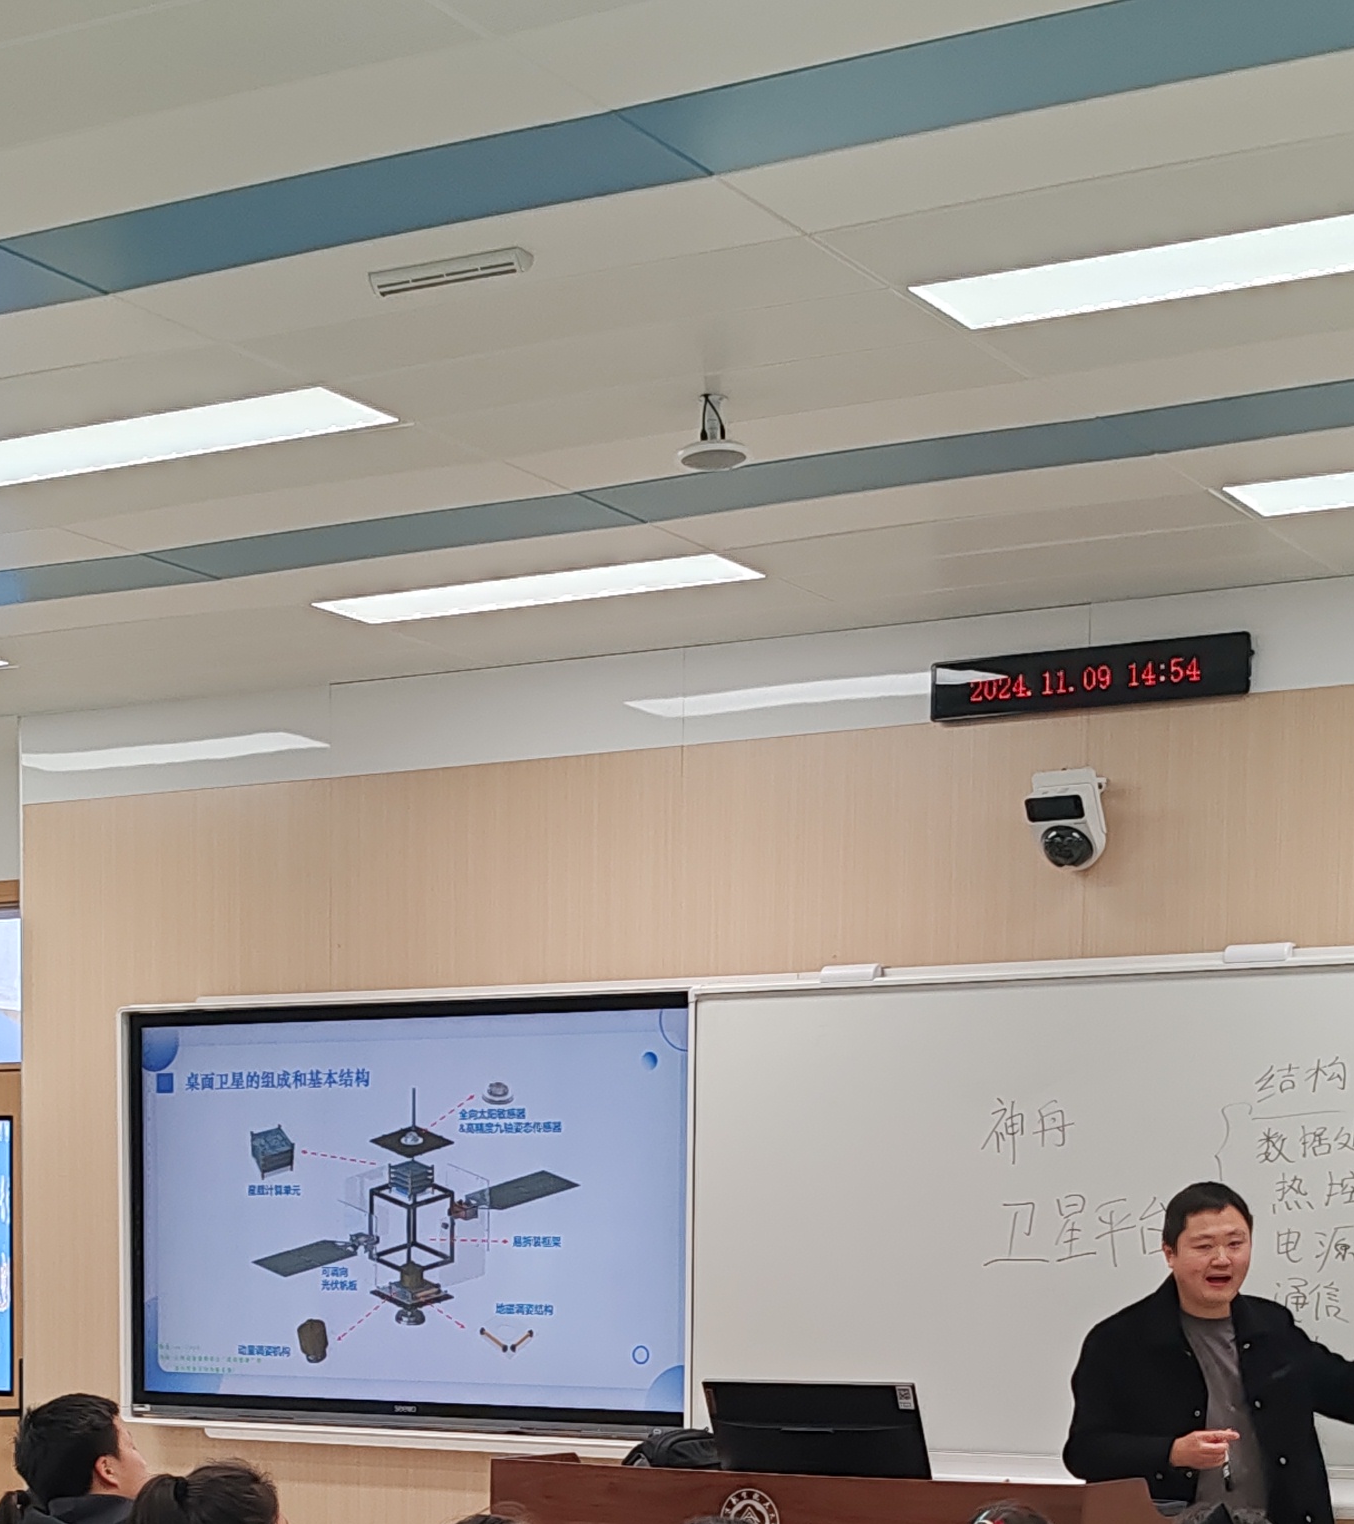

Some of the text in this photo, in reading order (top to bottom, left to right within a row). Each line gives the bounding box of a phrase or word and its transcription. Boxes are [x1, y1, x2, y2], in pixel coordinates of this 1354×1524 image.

[1127, 657, 1202, 688] 14:54
[184, 1067, 371, 1093] 桌面卫星的组成和基本结构
[1254, 1055, 1348, 1104] 结构
